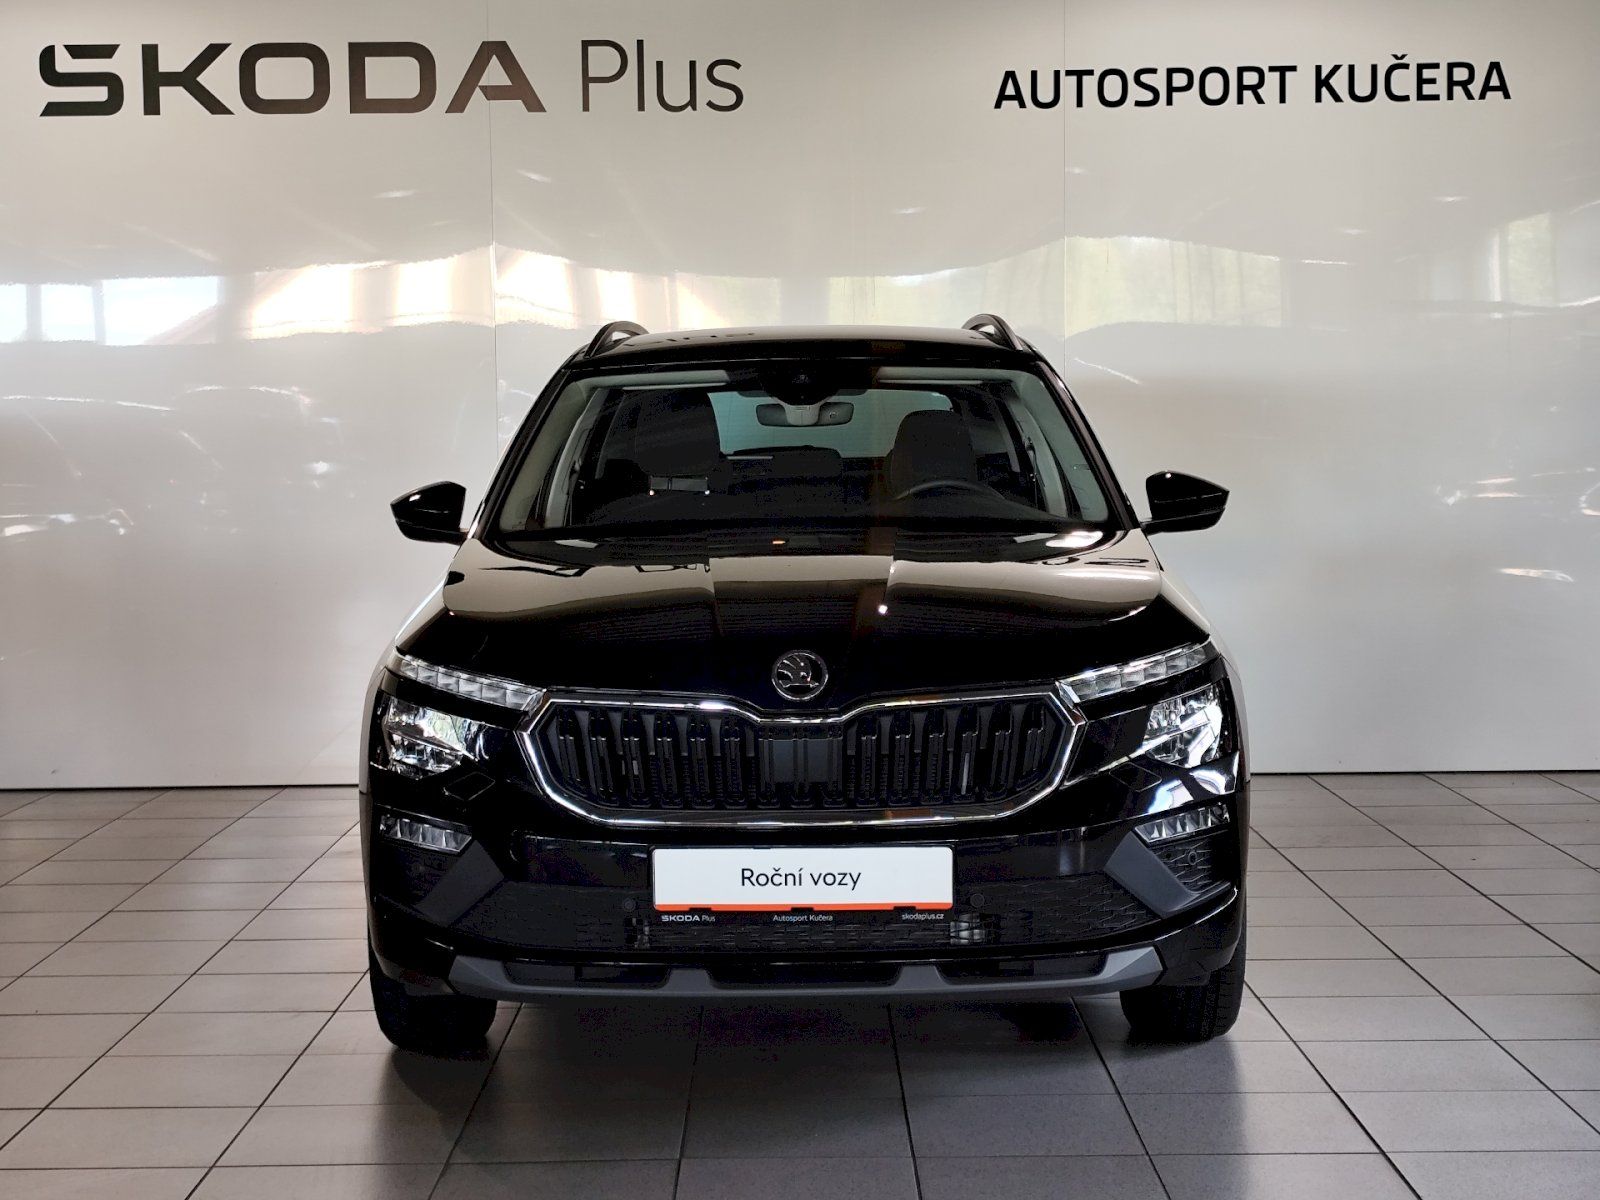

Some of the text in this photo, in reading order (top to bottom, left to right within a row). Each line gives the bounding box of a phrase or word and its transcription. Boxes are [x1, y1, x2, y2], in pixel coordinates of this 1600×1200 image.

[580, 38, 744, 113] Plus
[993, 53, 1512, 110] AUTOSPORT KUČERA
[740, 867, 862, 892] Roční vozy
[701, 914, 716, 922] Plus
[772, 914, 834, 923] Autosport Kučera
[901, 912, 945, 921] skodaplus.cz
